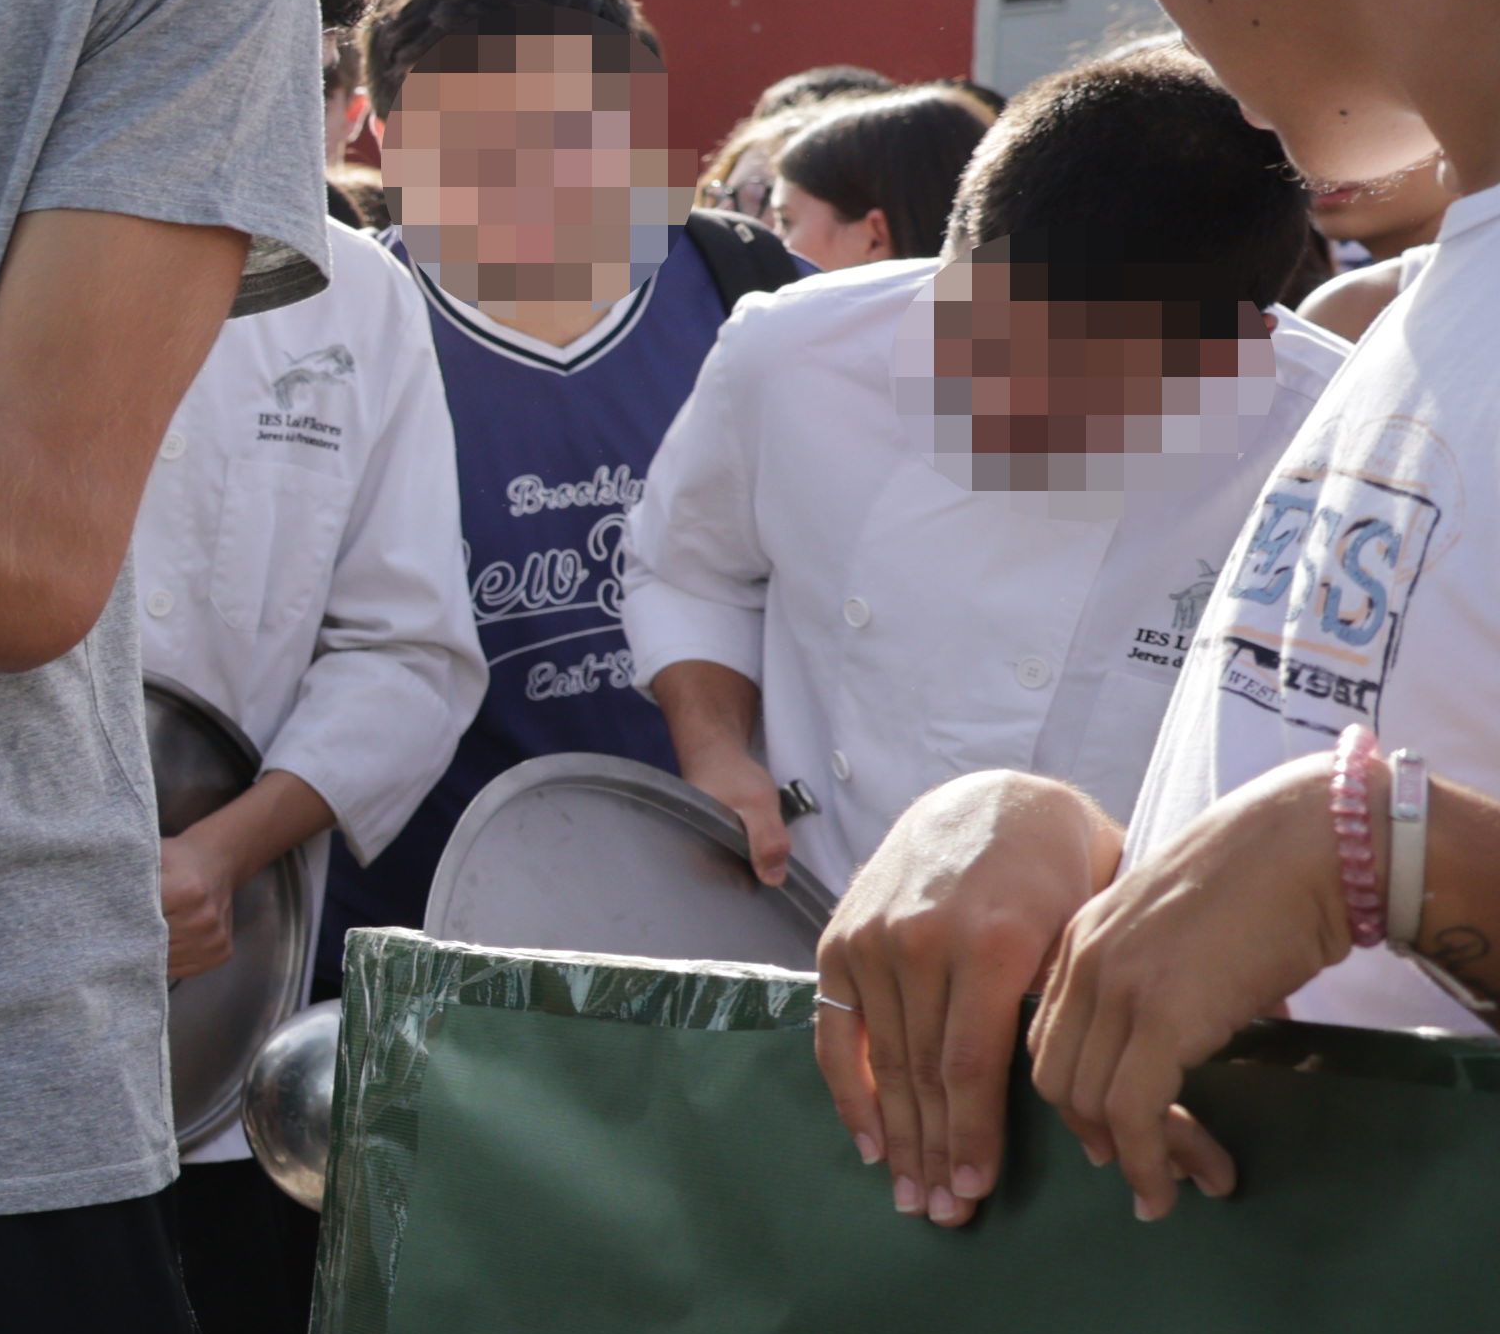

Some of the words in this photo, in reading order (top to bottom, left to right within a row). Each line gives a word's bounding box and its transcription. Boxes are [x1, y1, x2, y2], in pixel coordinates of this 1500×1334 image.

[506, 464, 648, 517] Brookly
[462, 537, 590, 619] ew
[1126, 647, 1170, 666] Jerez
[1134, 628, 1171, 647] IES
[1174, 635, 1191, 651] L
